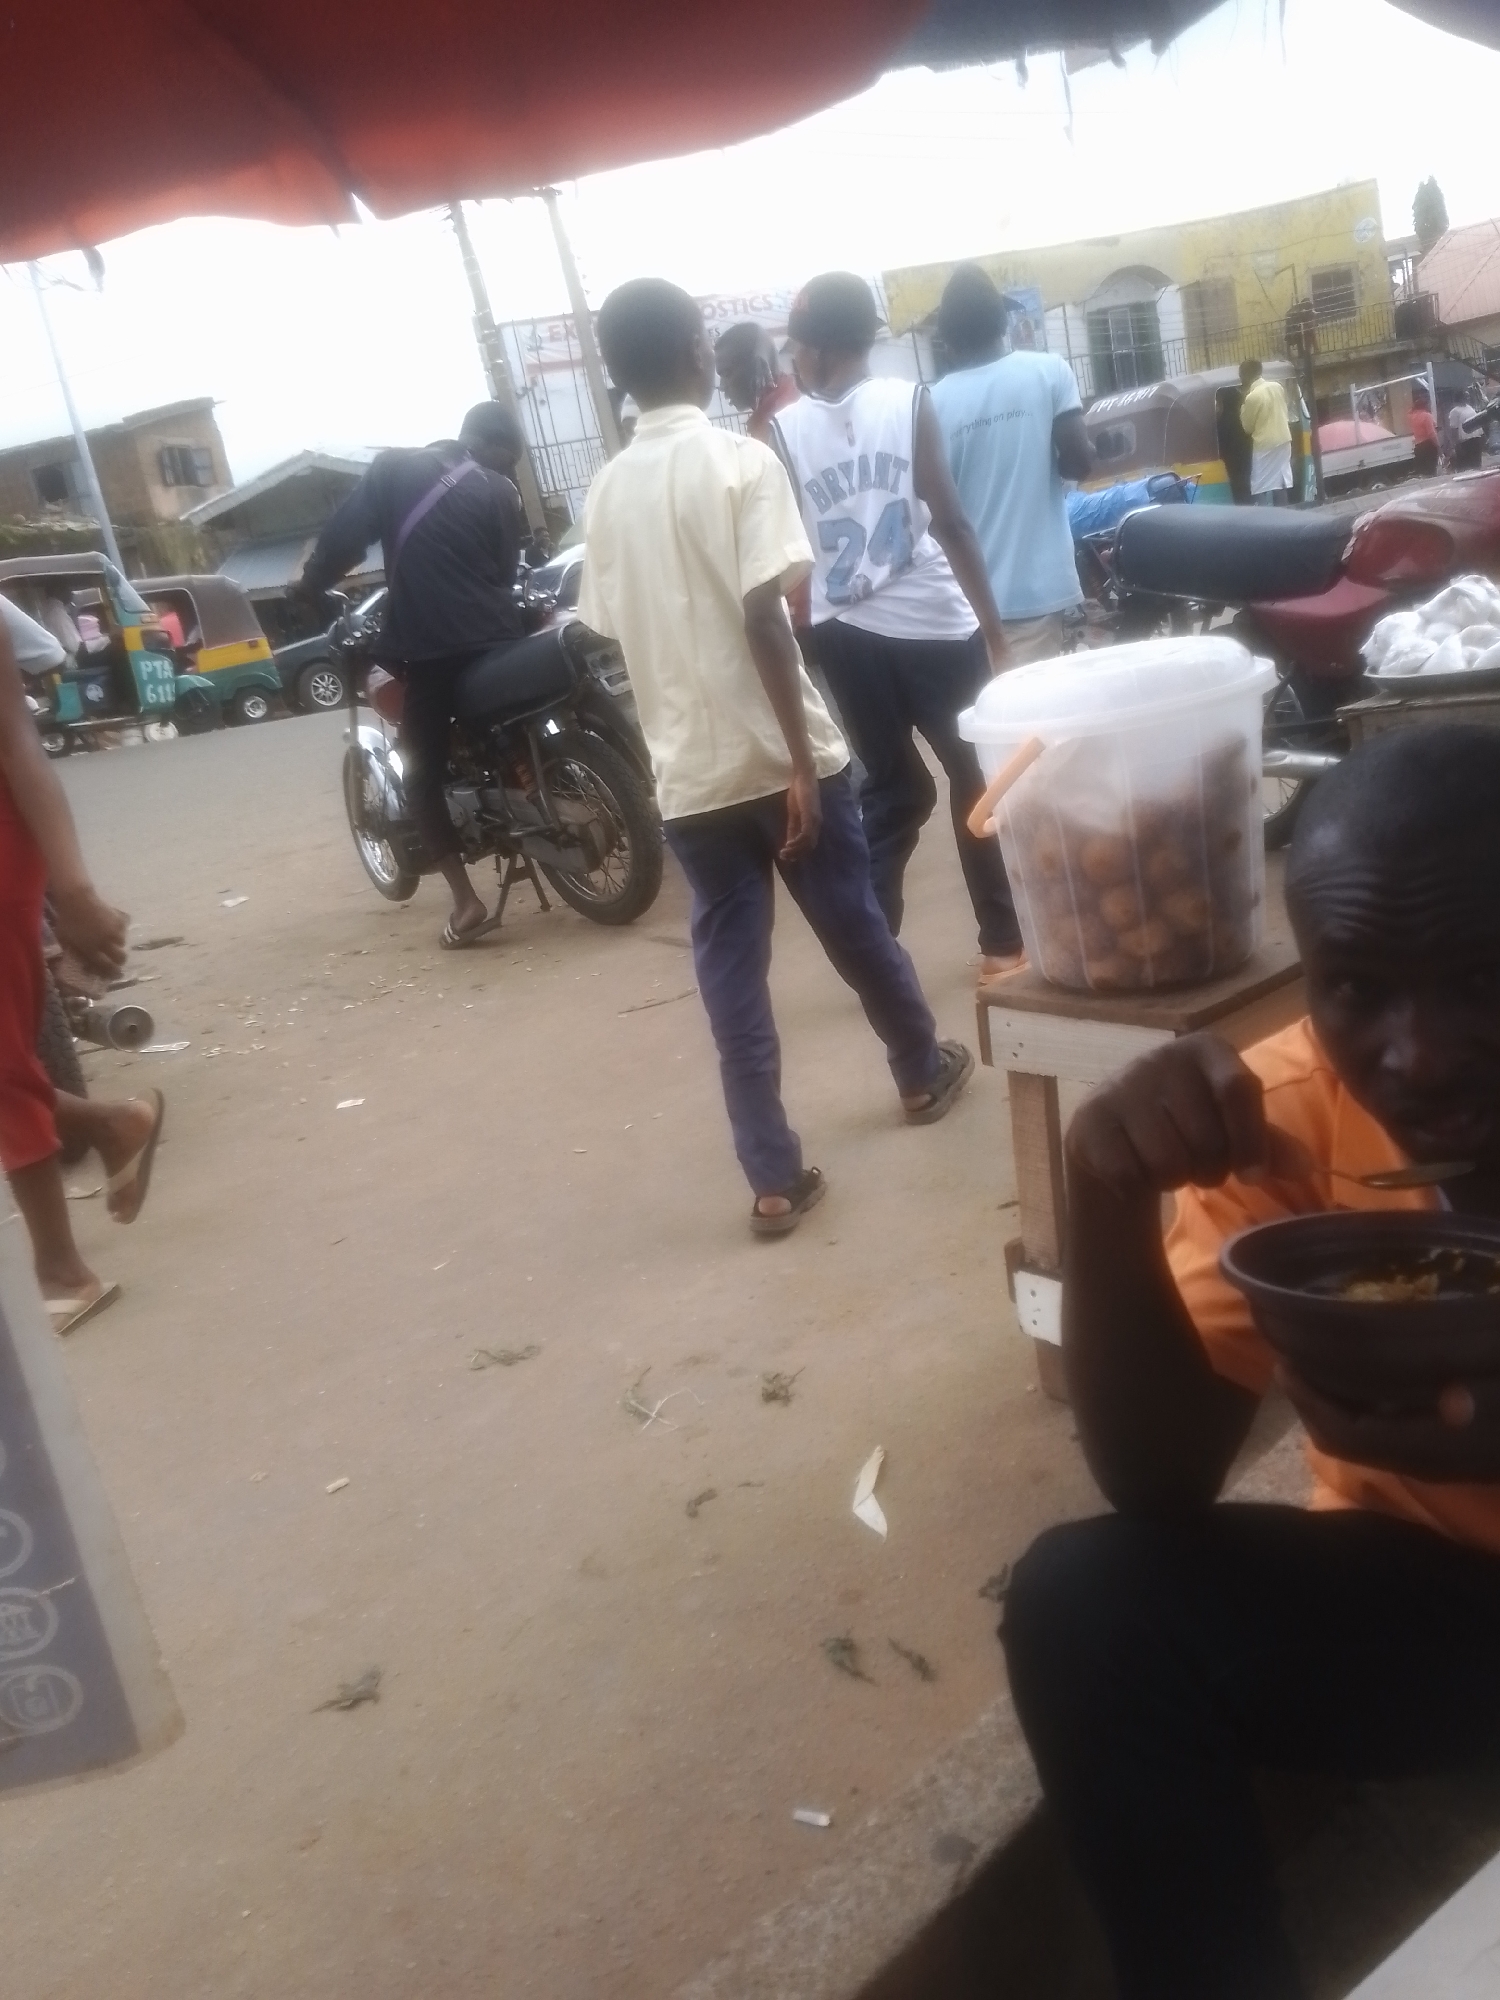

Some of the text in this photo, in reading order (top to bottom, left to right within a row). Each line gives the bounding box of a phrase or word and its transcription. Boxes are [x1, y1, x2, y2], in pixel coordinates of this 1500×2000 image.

[993, 413, 1004, 424] on
[804, 451, 910, 516] BRYANT
[817, 497, 915, 606] 24
